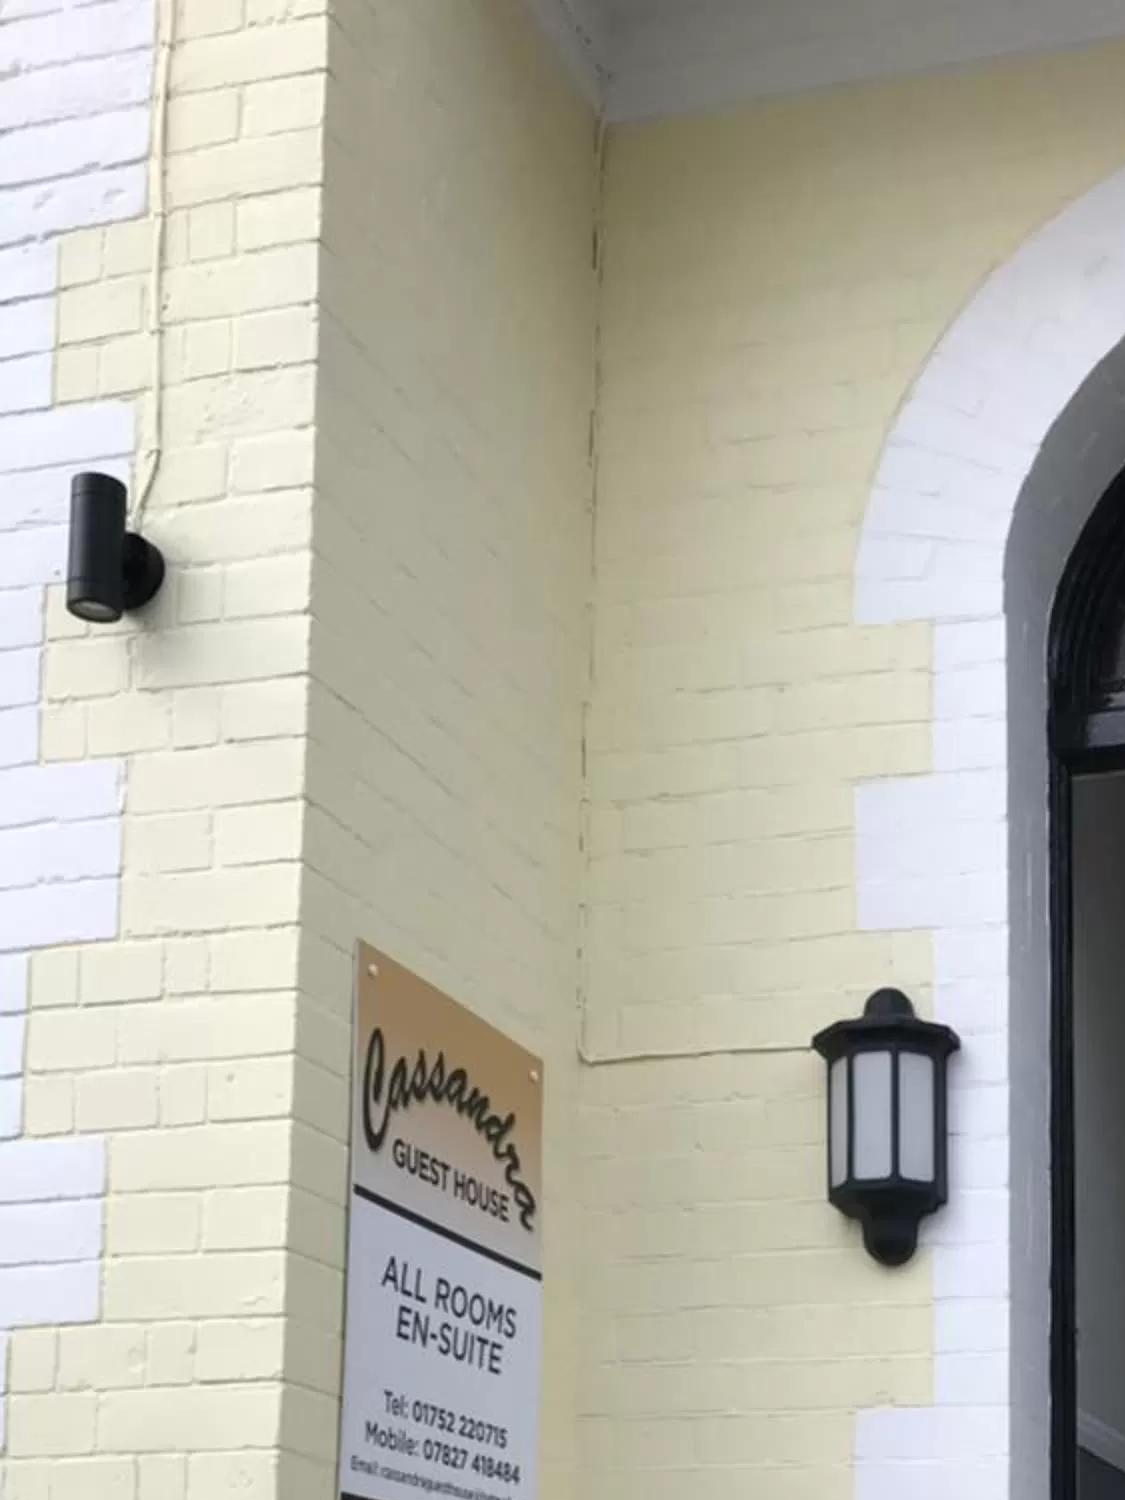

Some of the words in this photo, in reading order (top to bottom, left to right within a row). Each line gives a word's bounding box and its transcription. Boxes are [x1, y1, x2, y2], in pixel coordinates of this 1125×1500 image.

[363, 1026, 537, 1232] Cassandra
[392, 1138, 451, 1192] GUEST
[454, 1174, 510, 1223] HOUSE
[381, 1255, 428, 1303] ALL
[435, 1278, 517, 1340] ROOMS
[396, 1306, 503, 1375] EN-SUITE
[364, 1420, 420, 1456] Mobile:
[423, 1438, 468, 1471] 07827
[471, 1454, 521, 1487] 418484
[383, 1389, 410, 1420] Tel:
[412, 1400, 455, 1434] 01752
[459, 1414, 508, 1450] 220715
